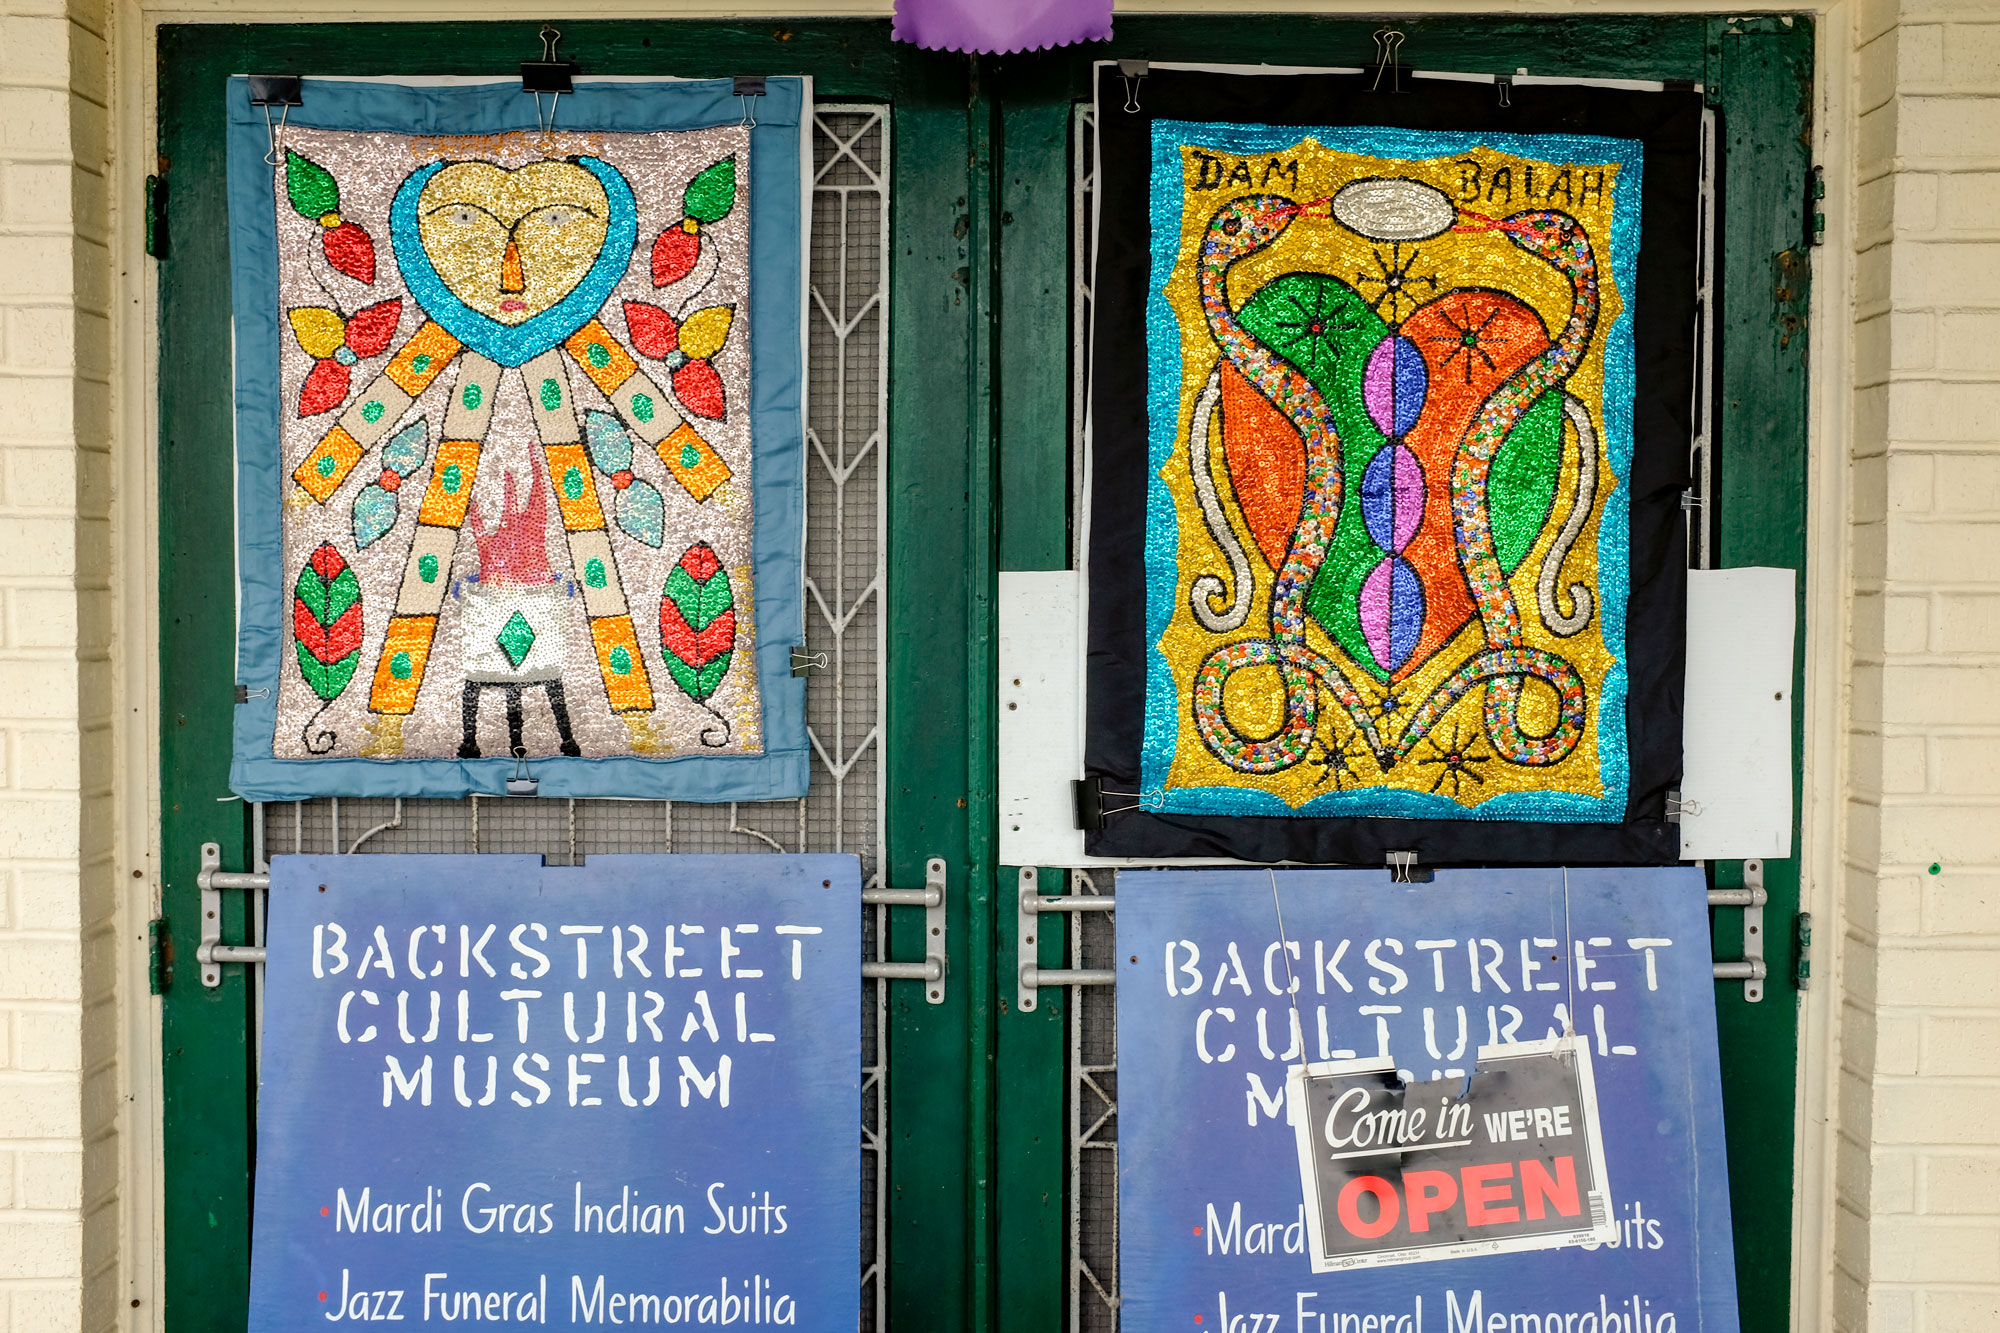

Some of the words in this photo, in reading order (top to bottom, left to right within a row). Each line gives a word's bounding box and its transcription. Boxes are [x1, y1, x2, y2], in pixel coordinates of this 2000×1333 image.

[1192, 150, 1299, 192] DAM
[312, 924, 823, 981] BACKSTREET
[1165, 937, 1673, 997] BACKSTREET
[336, 989, 776, 1043] CULTURAL
[382, 1053, 733, 1108] MUSEUM
[1325, 1087, 1426, 1149] Come
[1436, 1097, 1474, 1139] in
[1483, 1105, 1573, 1144] WE'RE
[335, 1186, 442, 1234] Mardi
[461, 1182, 554, 1235] Gras
[574, 1180, 685, 1235] Indian
[703, 1182, 789, 1235] Suits
[1337, 1156, 1581, 1239] OPEN
[1206, 1201, 1304, 1256] Mard
[324, 1268, 405, 1322] Jazz
[423, 1272, 547, 1325] Funeral
[571, 1275, 797, 1326] Memorabilia
